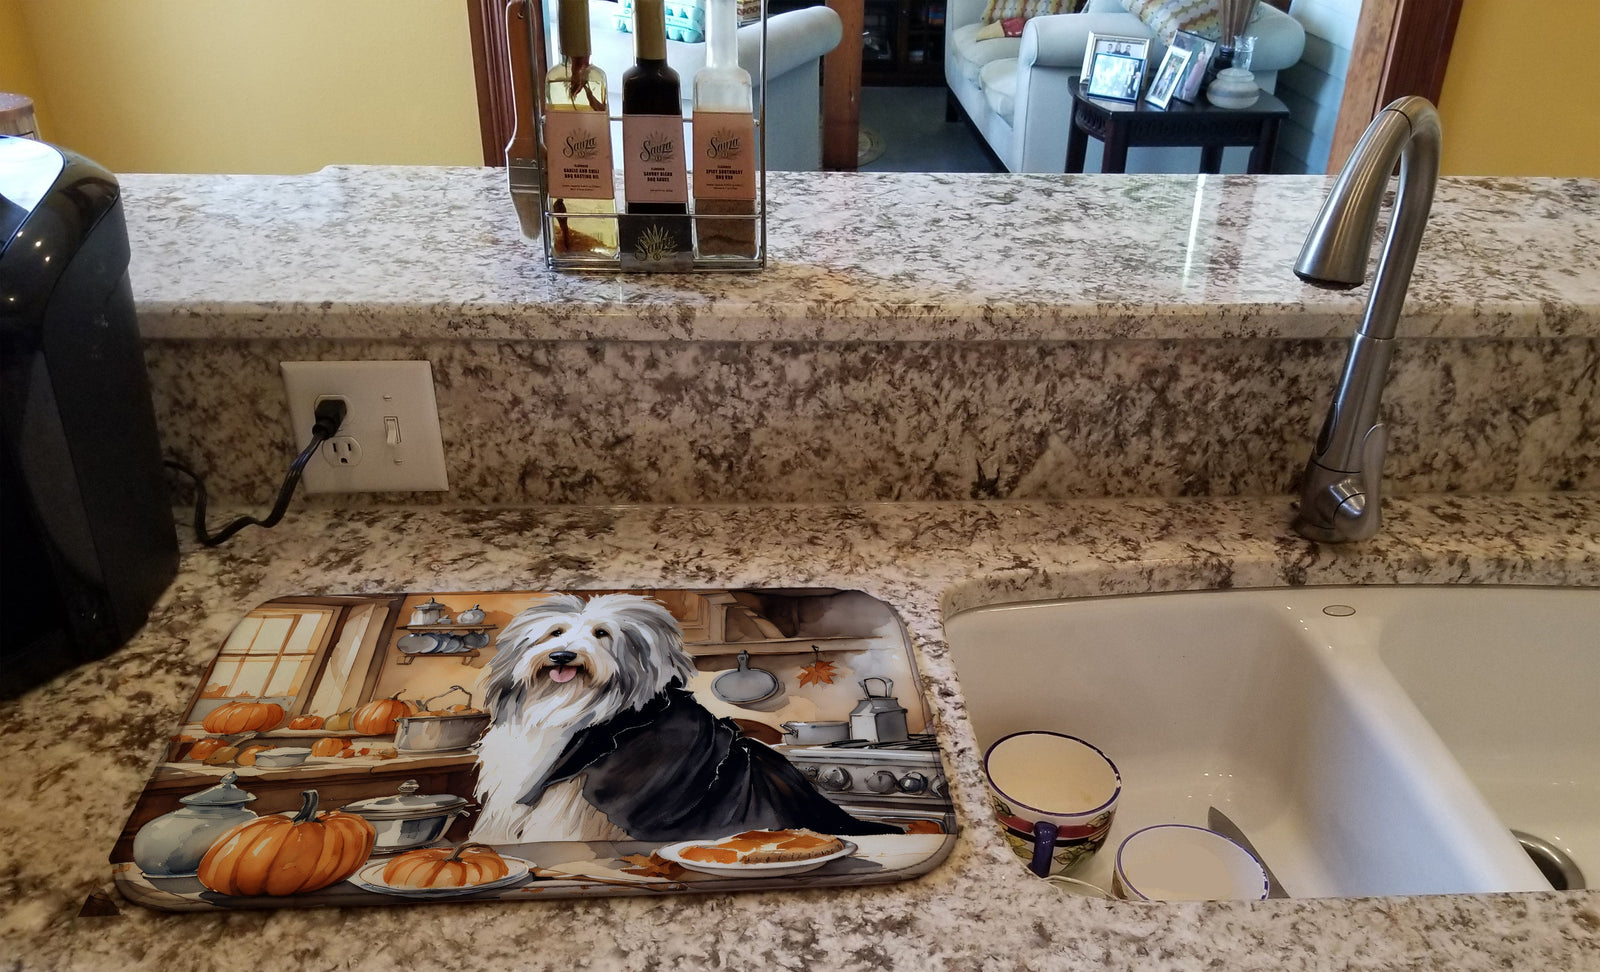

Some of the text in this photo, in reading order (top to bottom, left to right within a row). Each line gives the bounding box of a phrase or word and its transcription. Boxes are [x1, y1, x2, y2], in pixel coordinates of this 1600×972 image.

[563, 136, 598, 158] Sauza
[640, 139, 674, 162] Sauza
[707, 136, 741, 158] Sauza
